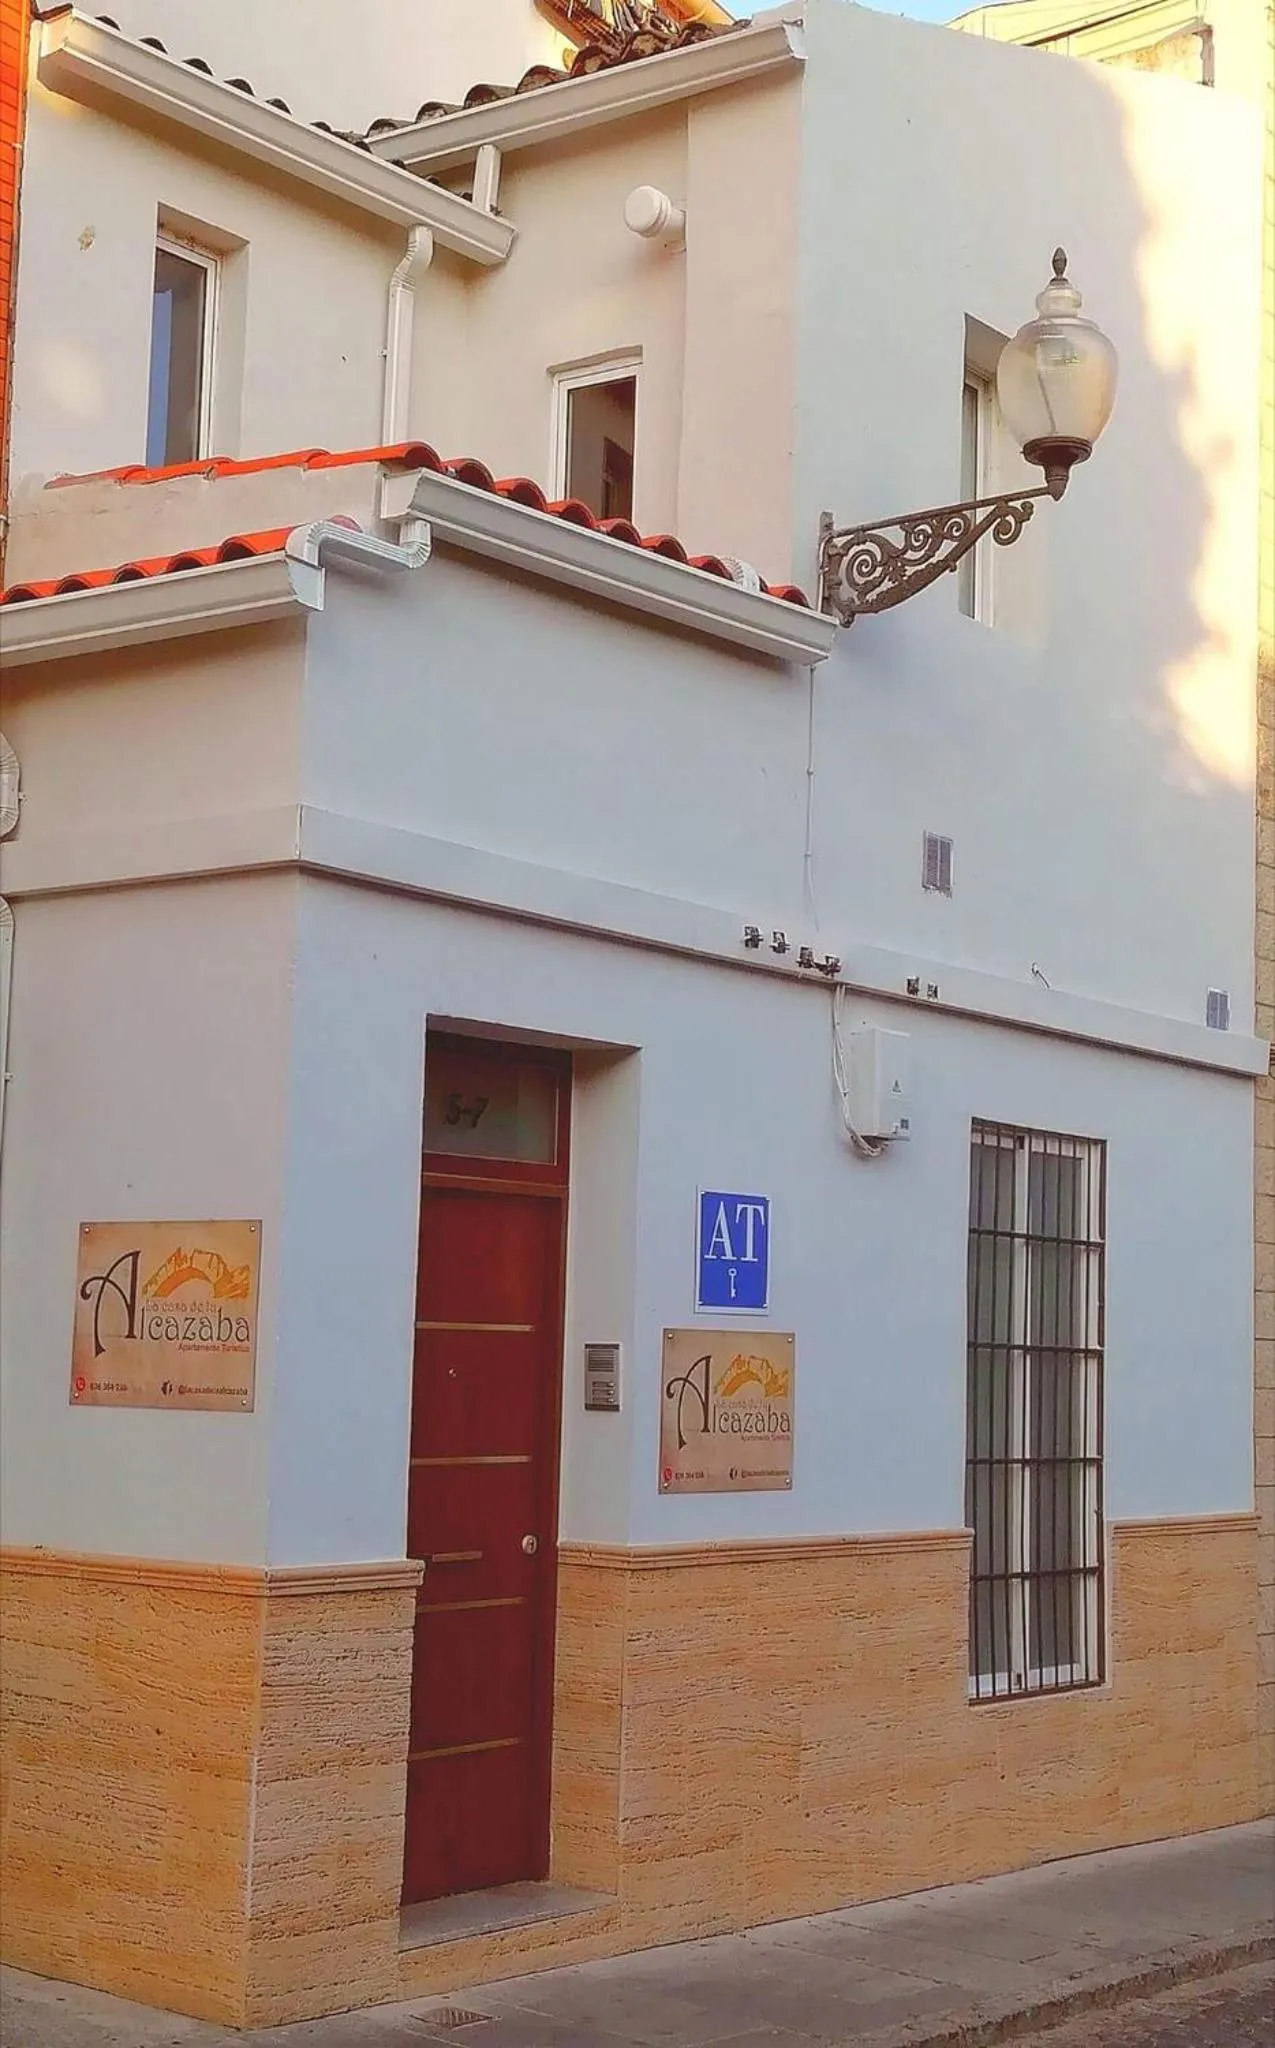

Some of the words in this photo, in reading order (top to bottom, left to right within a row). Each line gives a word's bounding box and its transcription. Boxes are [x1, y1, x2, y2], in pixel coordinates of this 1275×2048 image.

[704, 1201, 765, 1262] AT
[80, 1250, 250, 1358] Alcazaba
[666, 1355, 790, 1450] Alcazaba
